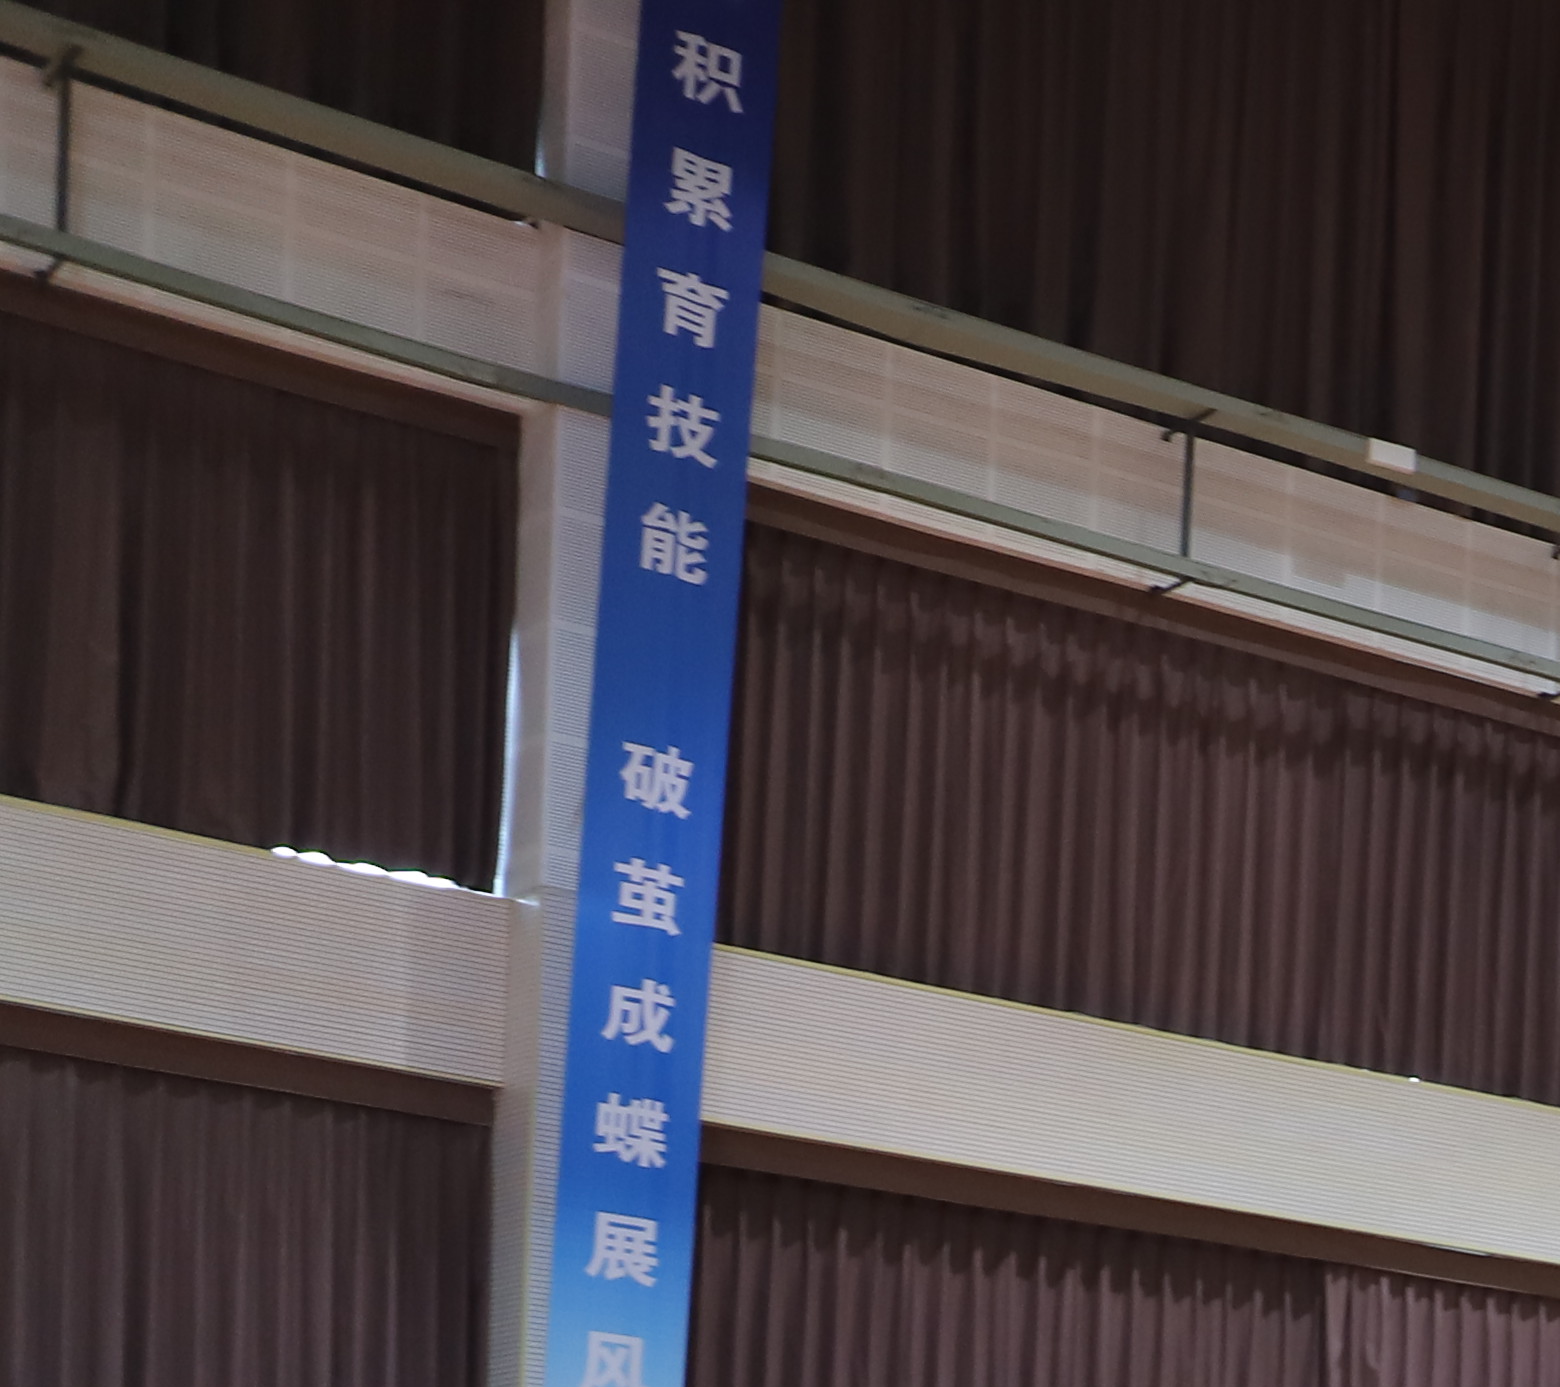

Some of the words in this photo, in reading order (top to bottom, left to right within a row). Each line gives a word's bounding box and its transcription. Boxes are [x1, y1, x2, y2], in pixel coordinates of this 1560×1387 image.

[638, 29, 745, 588] 积累育技能
